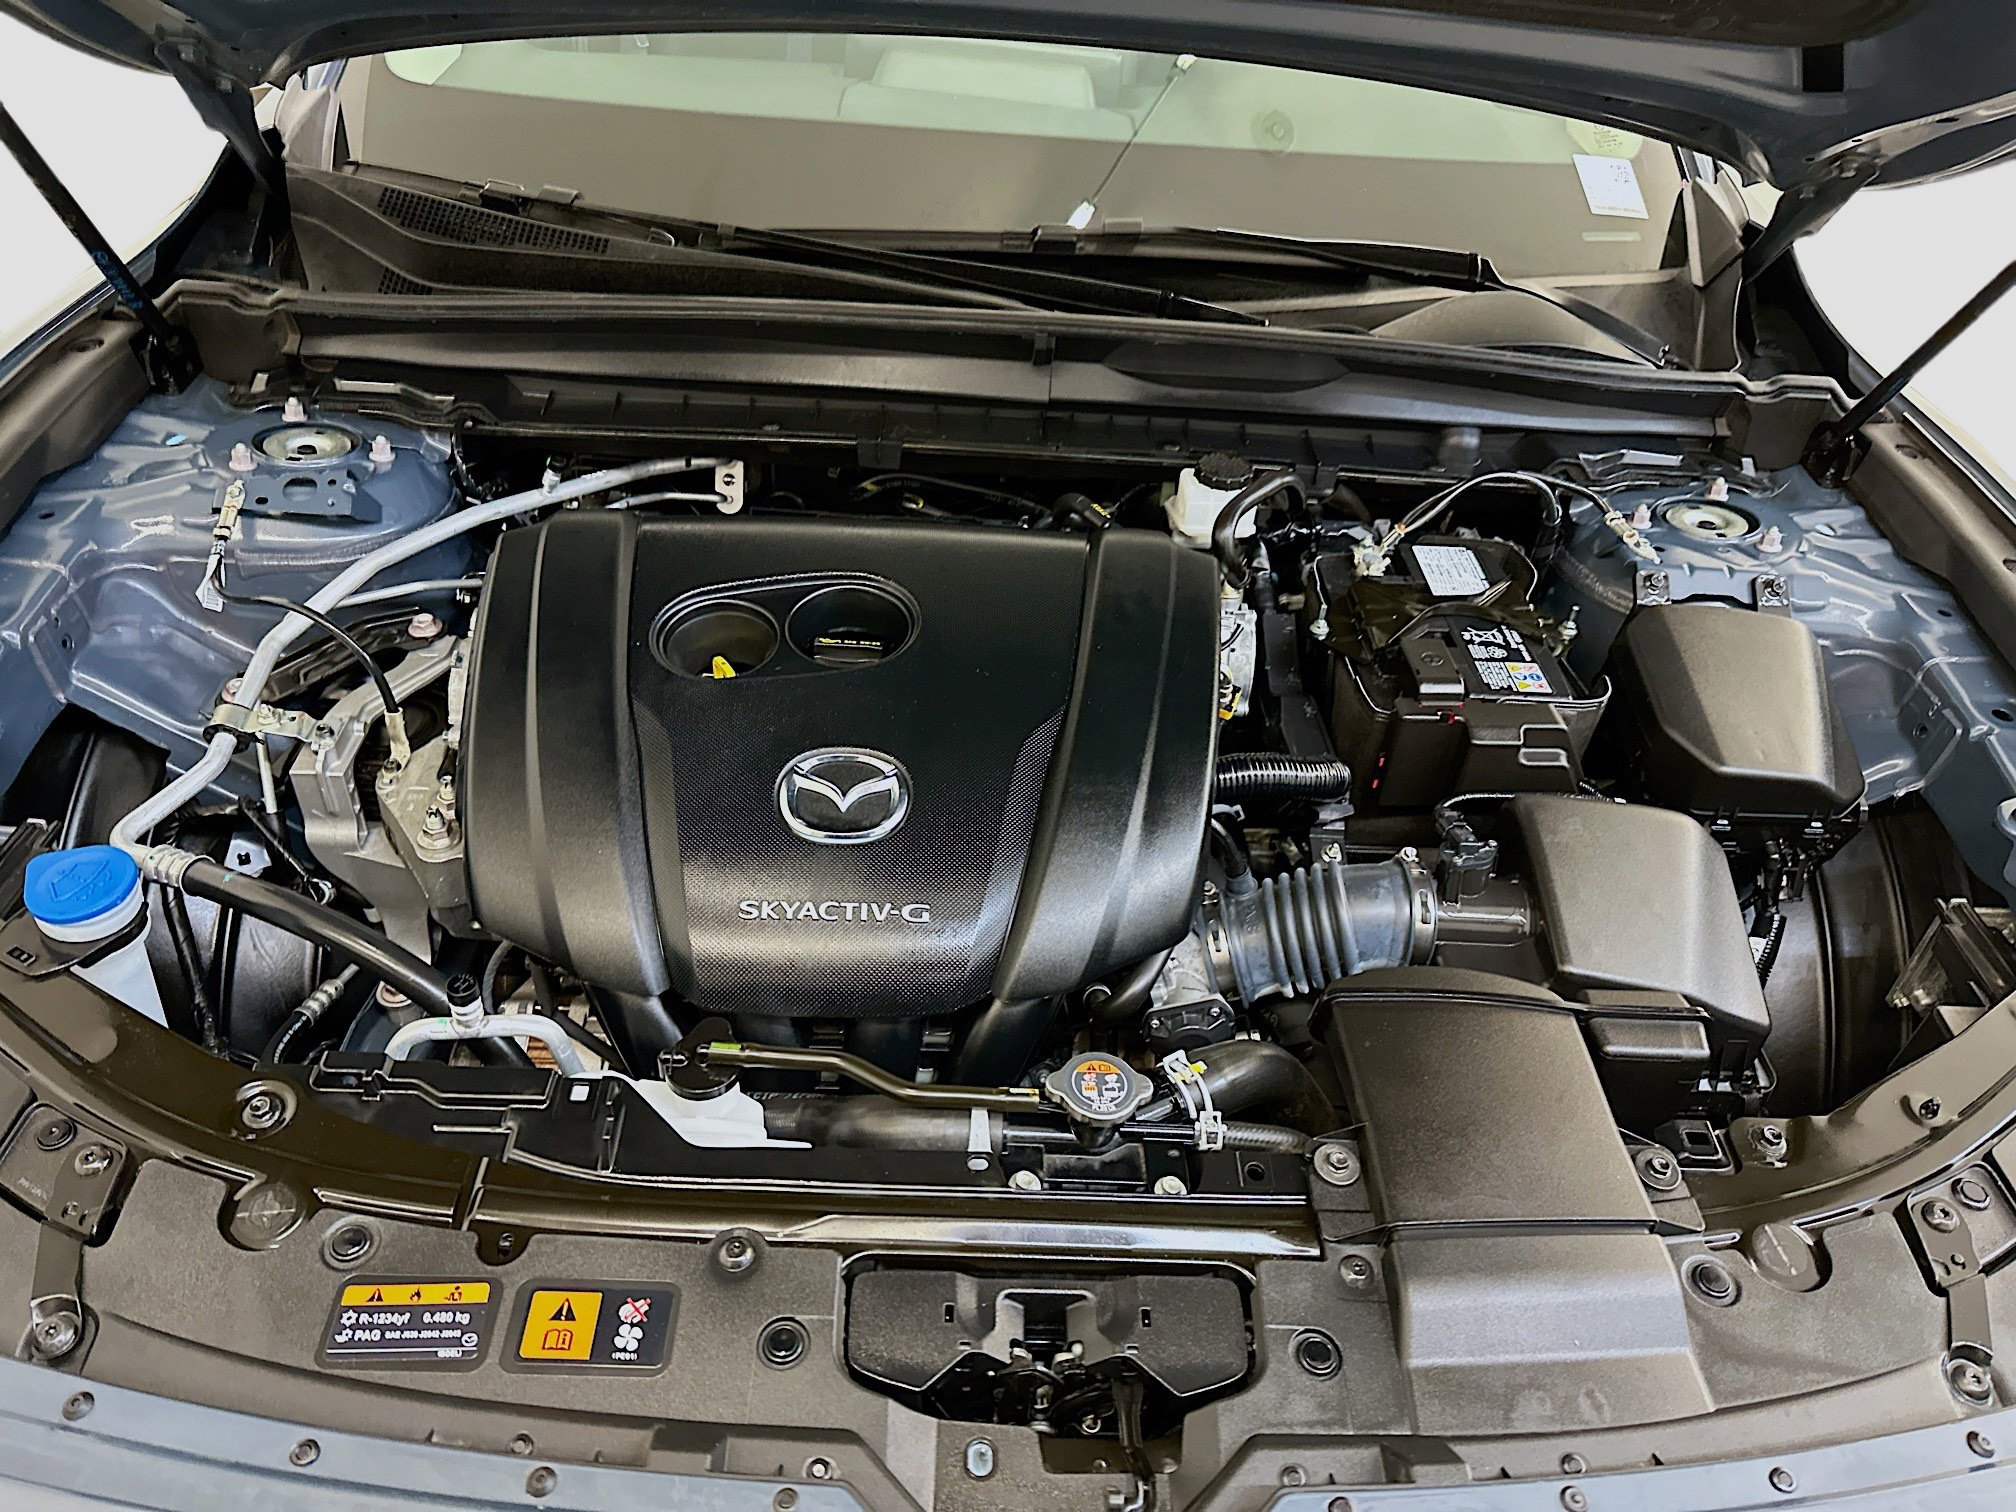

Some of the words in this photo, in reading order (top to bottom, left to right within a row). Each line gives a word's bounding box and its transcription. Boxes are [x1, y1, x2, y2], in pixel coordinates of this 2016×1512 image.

[737, 900, 930, 924] SKYACTIV-G
[358, 1312, 411, 1327] R-1234yf
[422, 1311, 454, 1324] 0.480
[454, 1310, 471, 1325] kg
[354, 1329, 382, 1342] PAG
